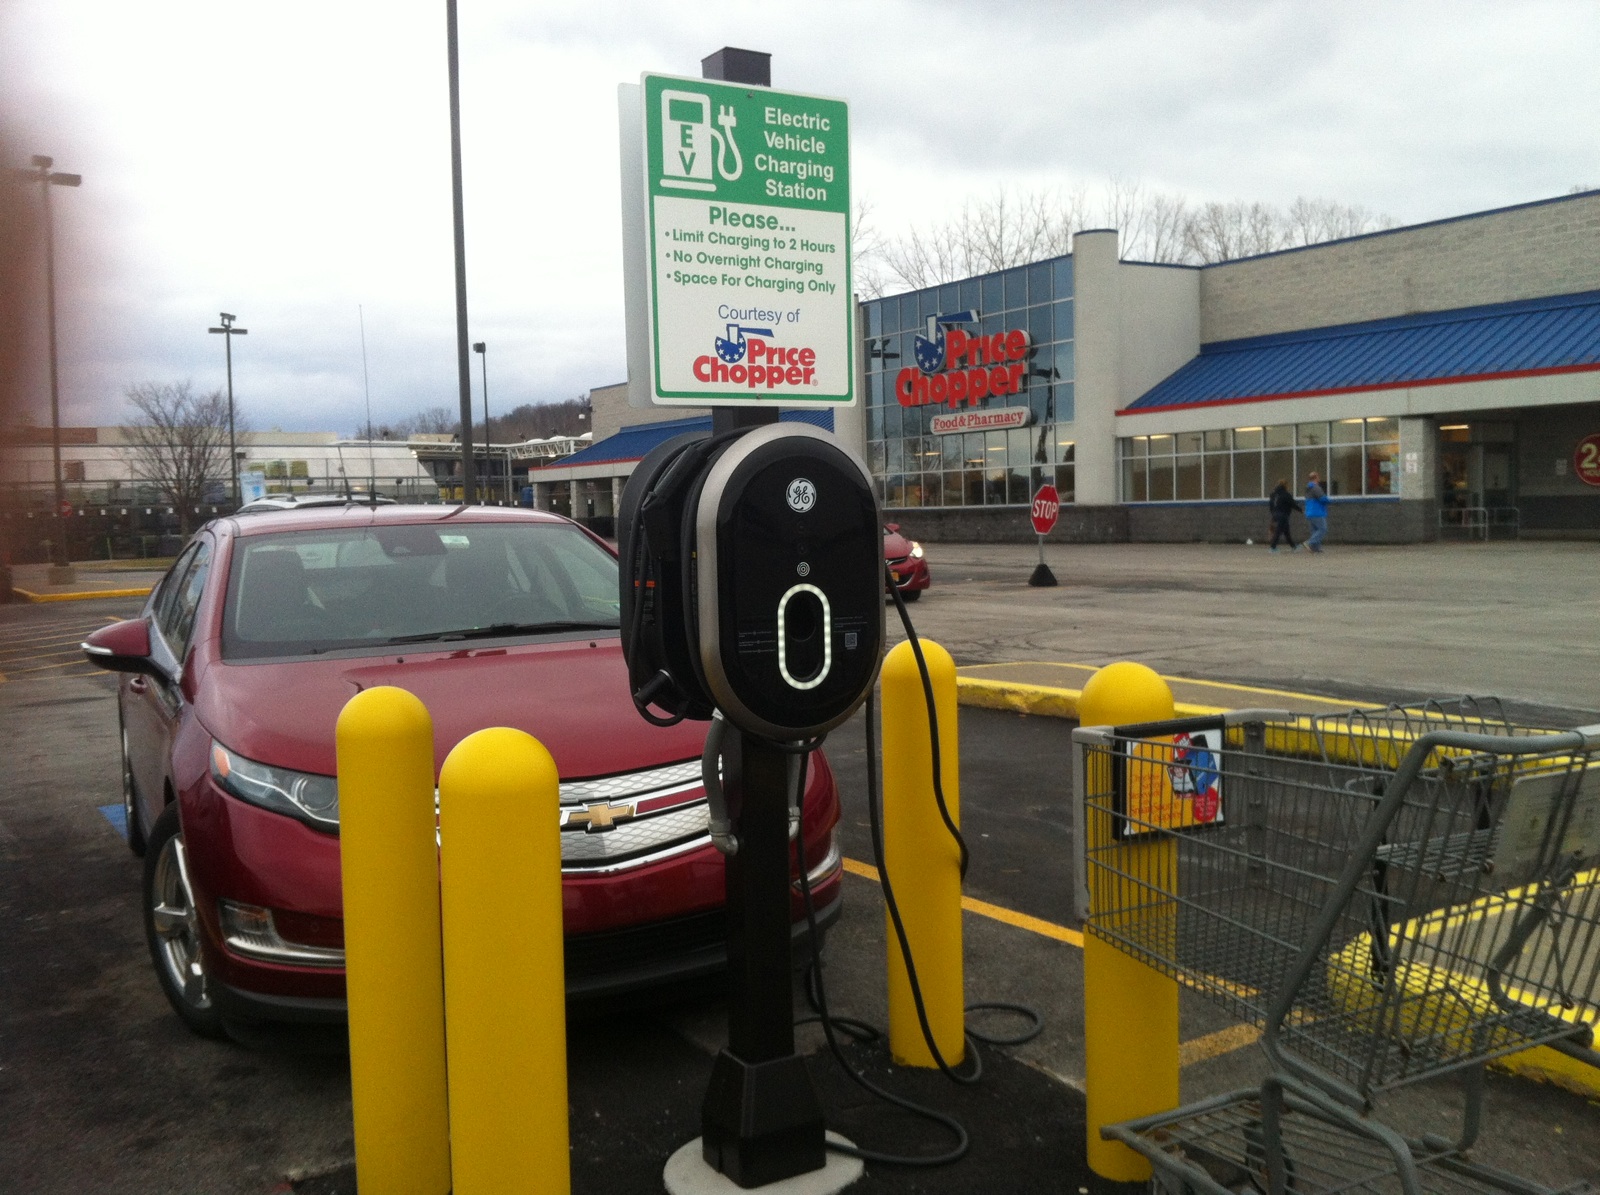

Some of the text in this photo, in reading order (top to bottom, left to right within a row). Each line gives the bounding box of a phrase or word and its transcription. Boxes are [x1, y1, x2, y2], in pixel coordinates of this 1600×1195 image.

[764, 106, 831, 132] Electric
[763, 130, 826, 154] Vehicle
[754, 154, 834, 183] Charging
[765, 179, 827, 201] Station
[708, 206, 796, 232] Please...
[672, 229, 836, 253] Limit Charging to 2 Hours
[673, 250, 823, 275] No Overnight Charging
[673, 271, 836, 295] Space For Charging Only
[718, 304, 800, 326] Courtesy of
[747, 338, 816, 365] Price
[946, 329, 1029, 369] Price
[692, 355, 816, 389] Chopper
[895, 362, 1025, 409] Chopper
[1581, 443, 1600, 469] 2
[1033, 499, 1058, 519] STOP
